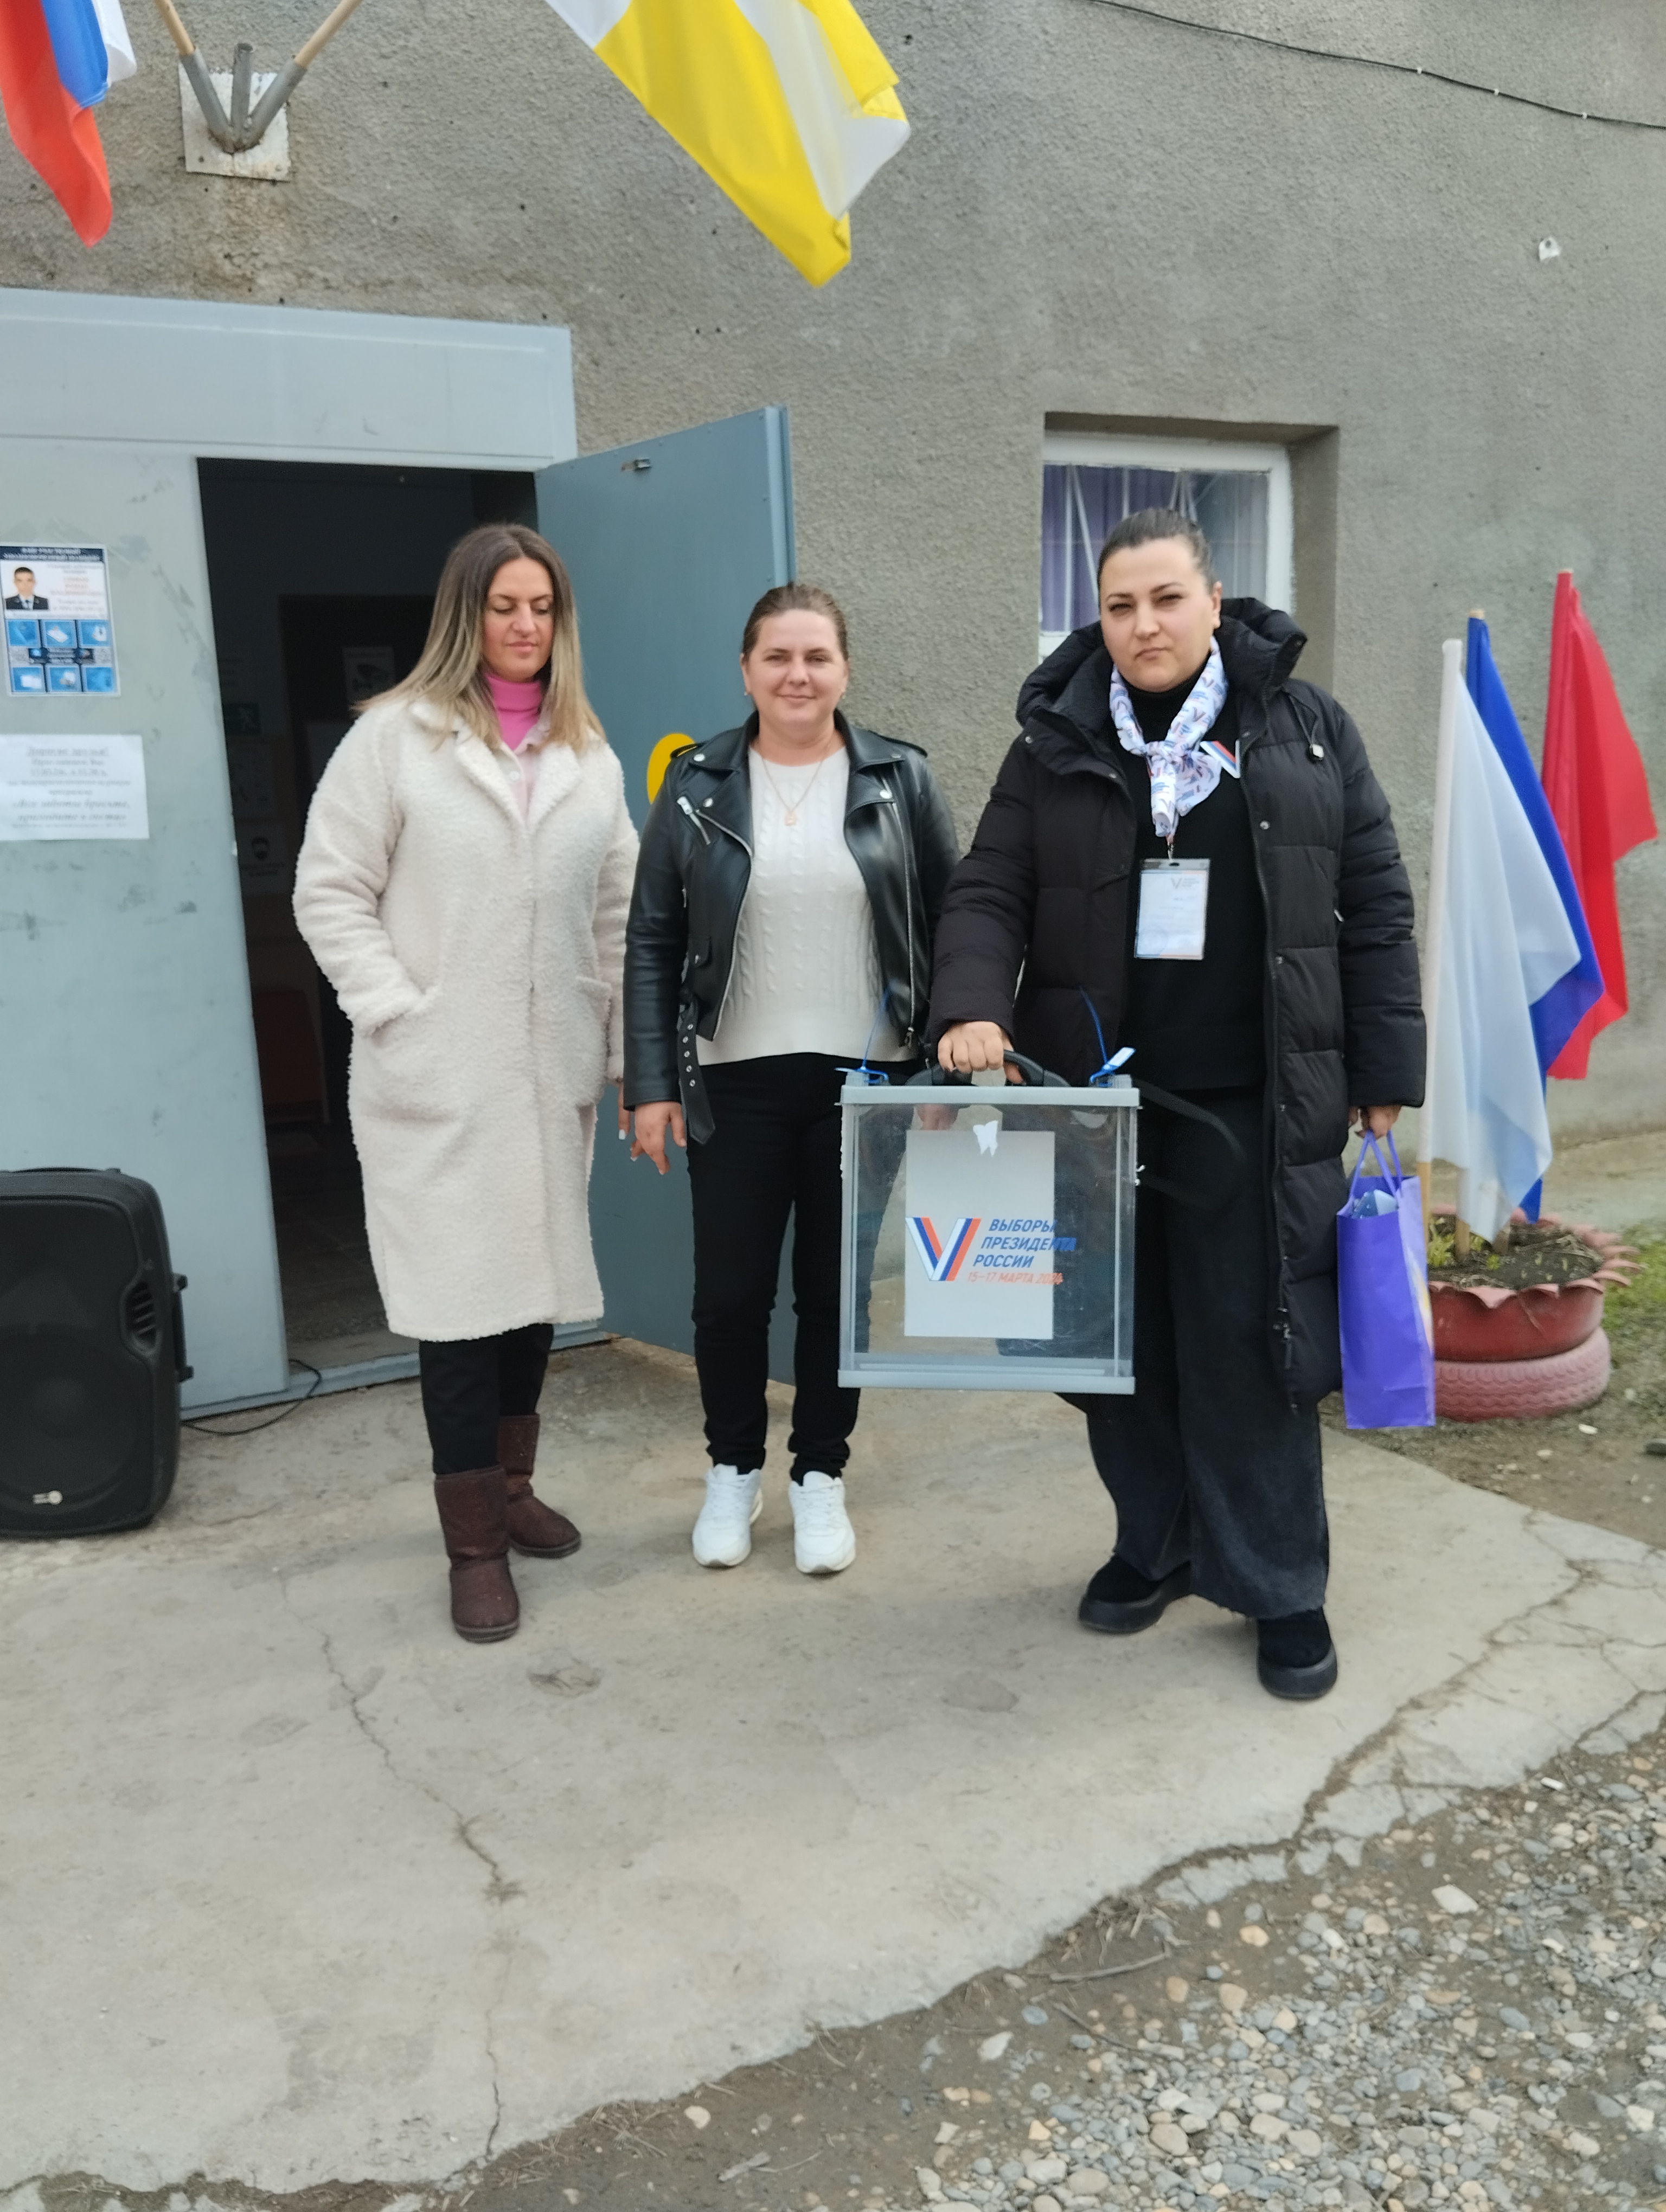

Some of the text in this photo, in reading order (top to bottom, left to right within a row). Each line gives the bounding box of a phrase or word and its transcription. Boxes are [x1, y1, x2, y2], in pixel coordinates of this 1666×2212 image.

[989, 1218, 1057, 1232] ВЫБОРЫ
[972, 1254, 1035, 1268] РОССИИ
[998, 1272, 1034, 1284] МАРТА
